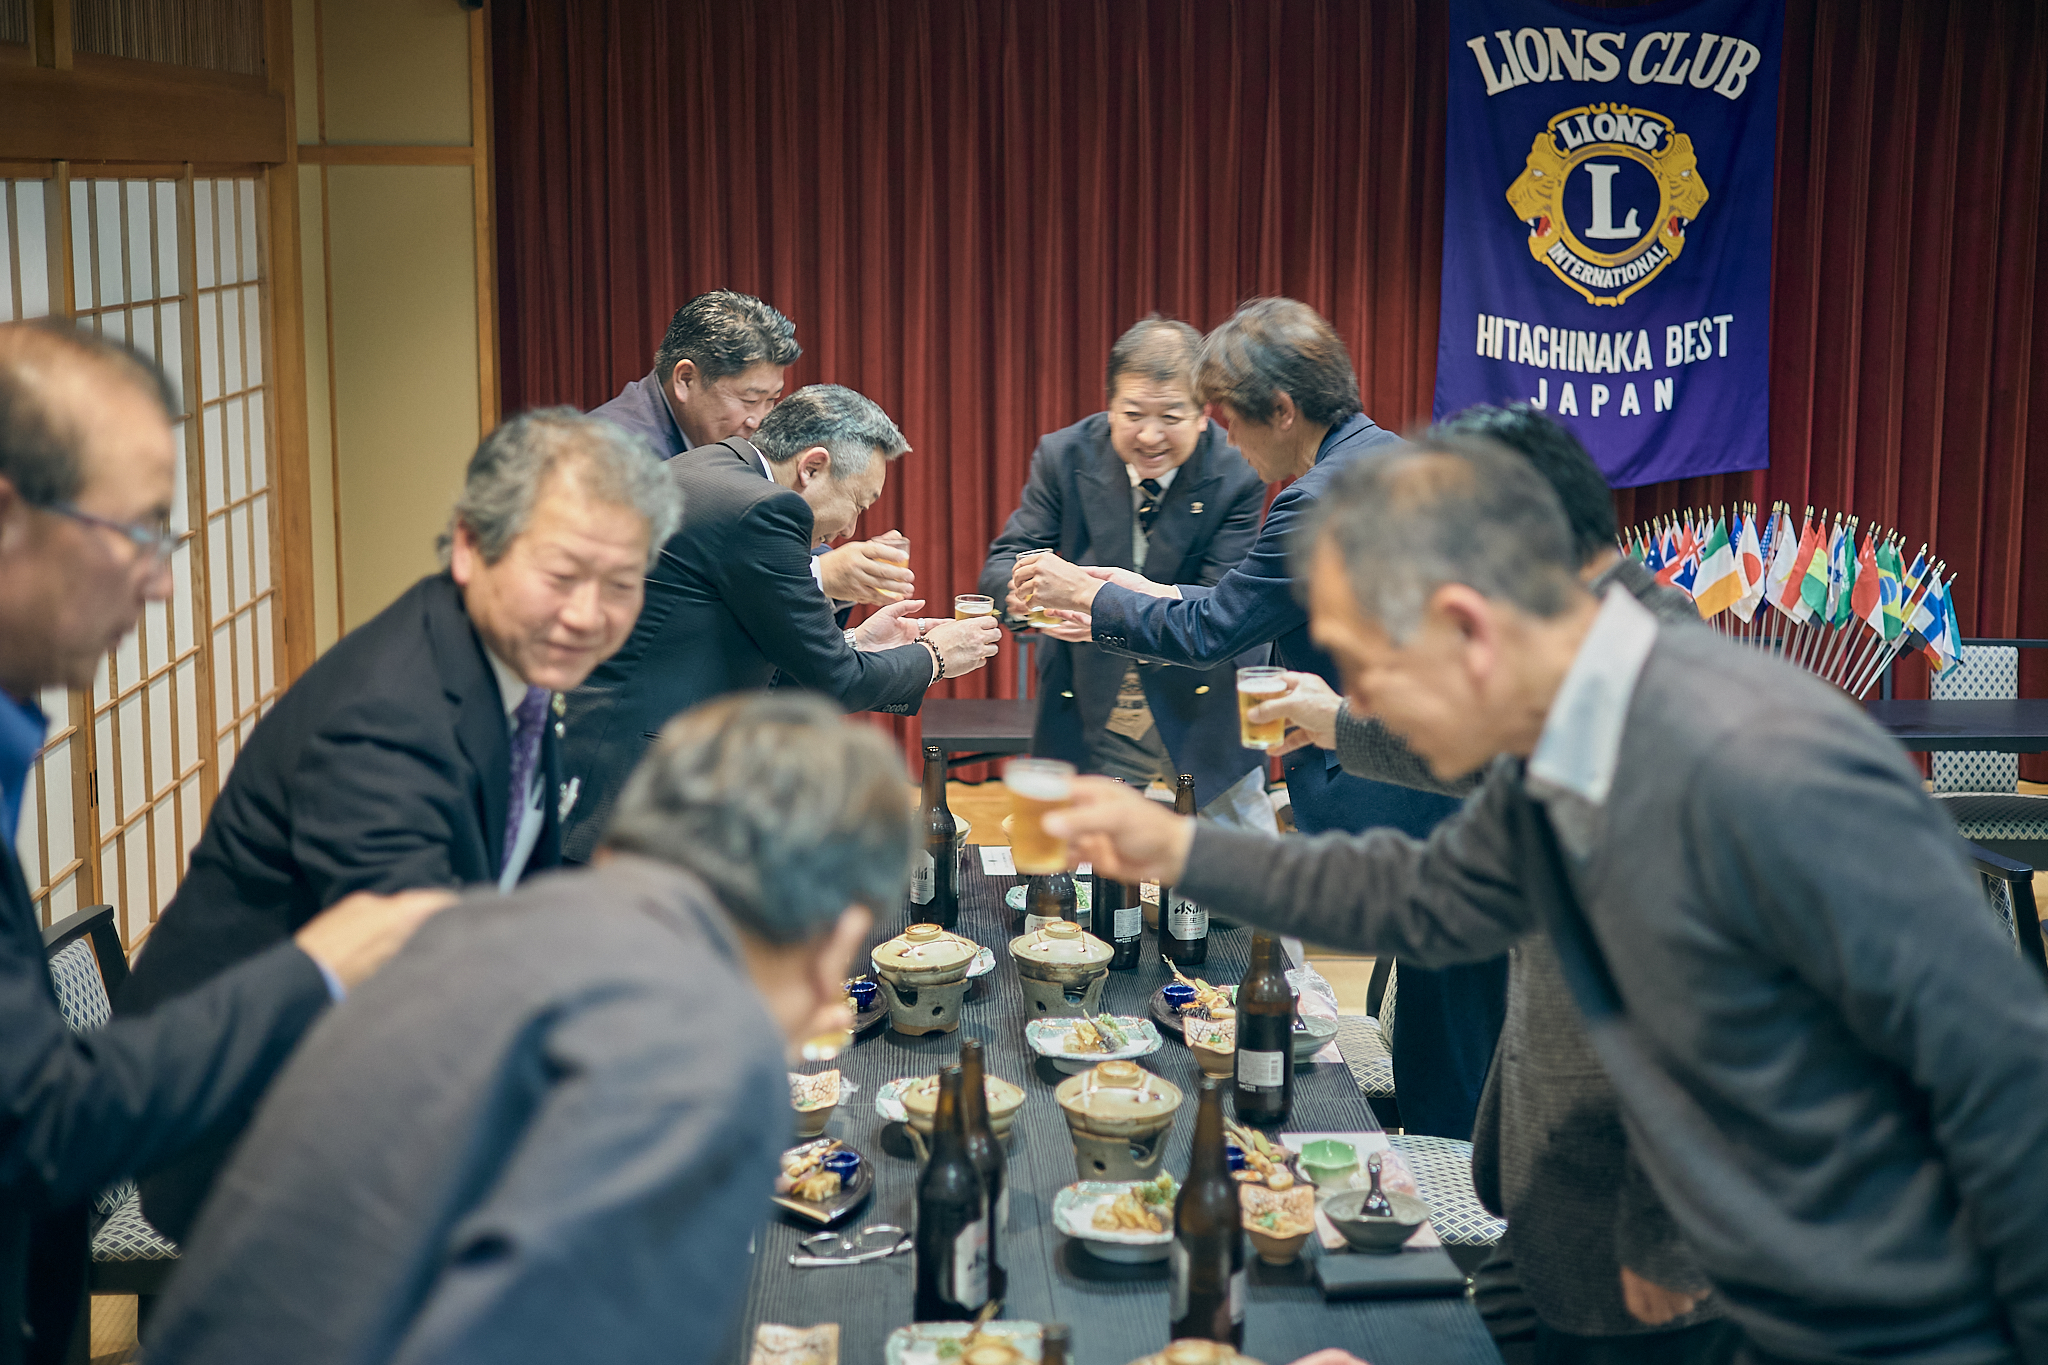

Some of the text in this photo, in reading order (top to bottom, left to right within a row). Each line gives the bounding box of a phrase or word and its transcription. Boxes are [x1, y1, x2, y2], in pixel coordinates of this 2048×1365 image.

[1466, 27, 1761, 100] LIONS CLUB
[1556, 112, 1665, 150] LIONS
[1584, 162, 1642, 239] L
[1547, 240, 1669, 289] INTERNATIONAL
[1476, 313, 1734, 374] HITACHINAKA BEST
[1529, 377, 1674, 418] JAPAN
